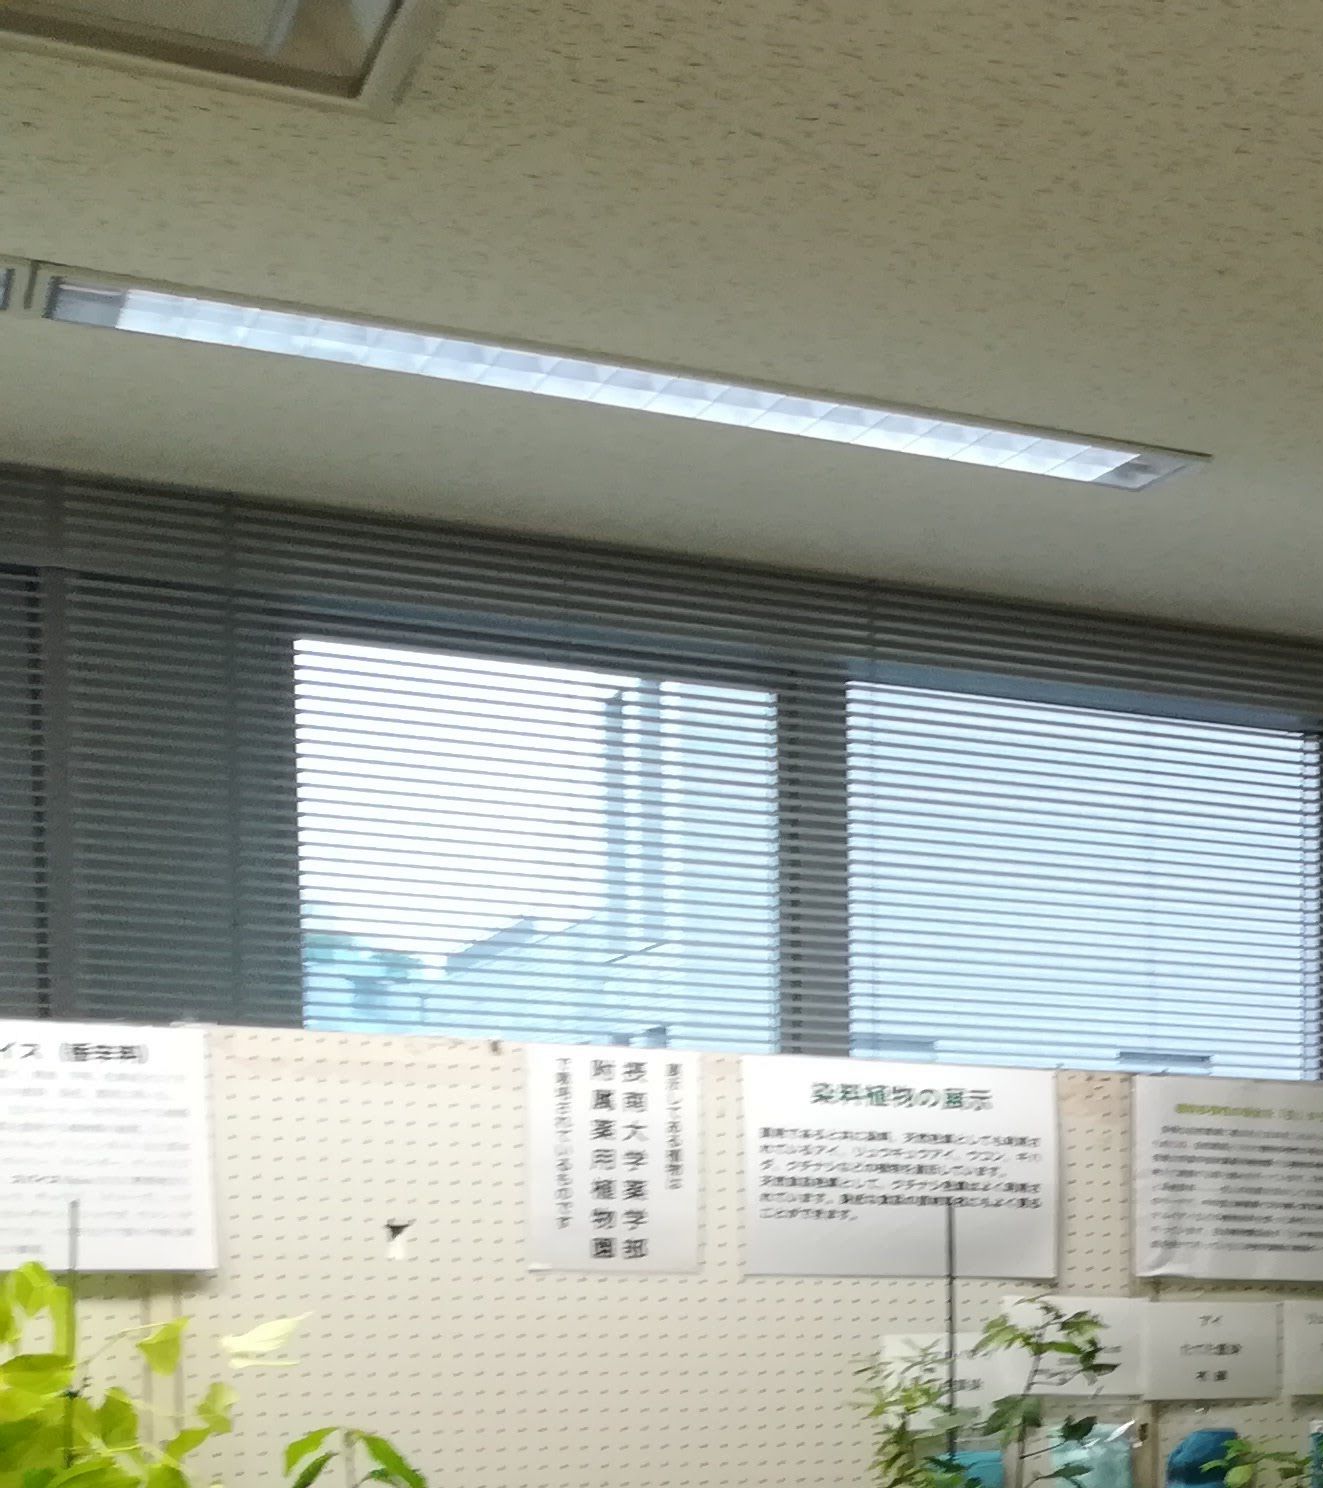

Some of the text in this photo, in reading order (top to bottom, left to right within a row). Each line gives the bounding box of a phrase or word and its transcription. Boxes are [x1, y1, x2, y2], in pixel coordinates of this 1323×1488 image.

[809, 1081, 995, 1112] 染料植物の展示
[621, 1061, 650, 1260] 摂南大学薬学部
